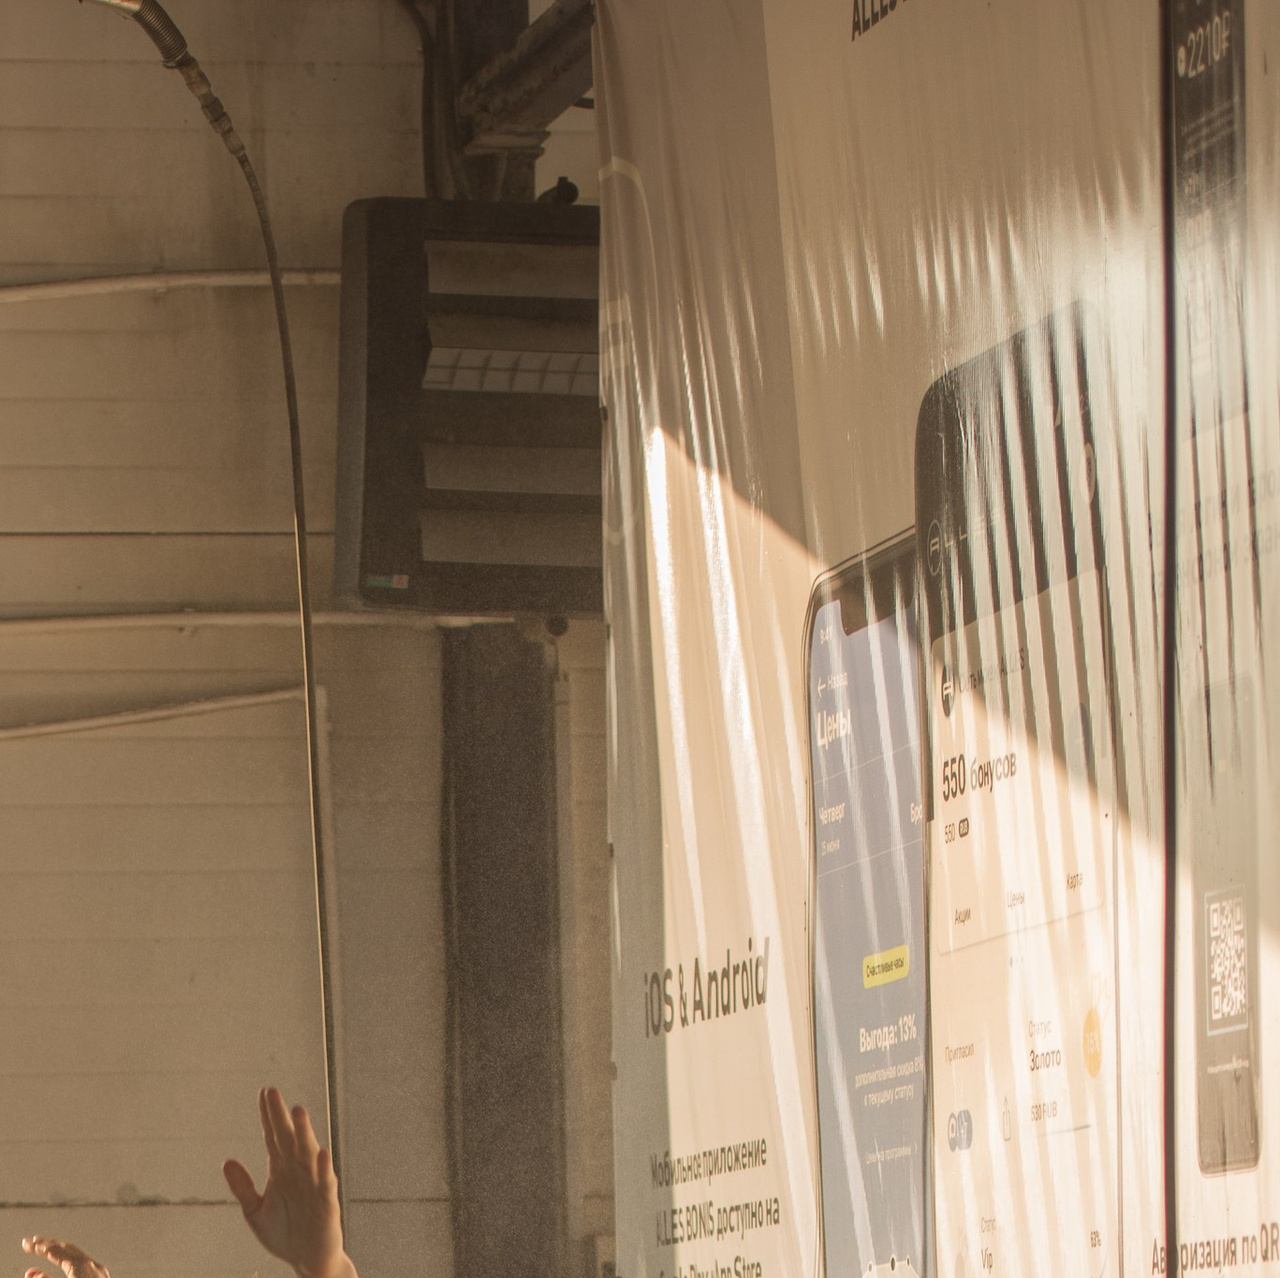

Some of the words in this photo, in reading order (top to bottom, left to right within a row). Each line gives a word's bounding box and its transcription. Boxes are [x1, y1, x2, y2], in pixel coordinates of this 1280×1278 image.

[818, 708, 851, 750] Цены
[942, 753, 966, 802] 550
[970, 751, 1017, 793] бонусов
[644, 968, 675, 1038] iOS
[678, 963, 689, 1028] &
[693, 936, 770, 1024] Android
[859, 1023, 898, 1053] Выгода:
[899, 1013, 917, 1043] 13%
[1029, 1049, 1062, 1071] Золото
[702, 1138, 767, 1186] приложение
[717, 1200, 764, 1242] доступно
[766, 1196, 780, 1226] на
[1242, 1235, 1258, 1264] по
